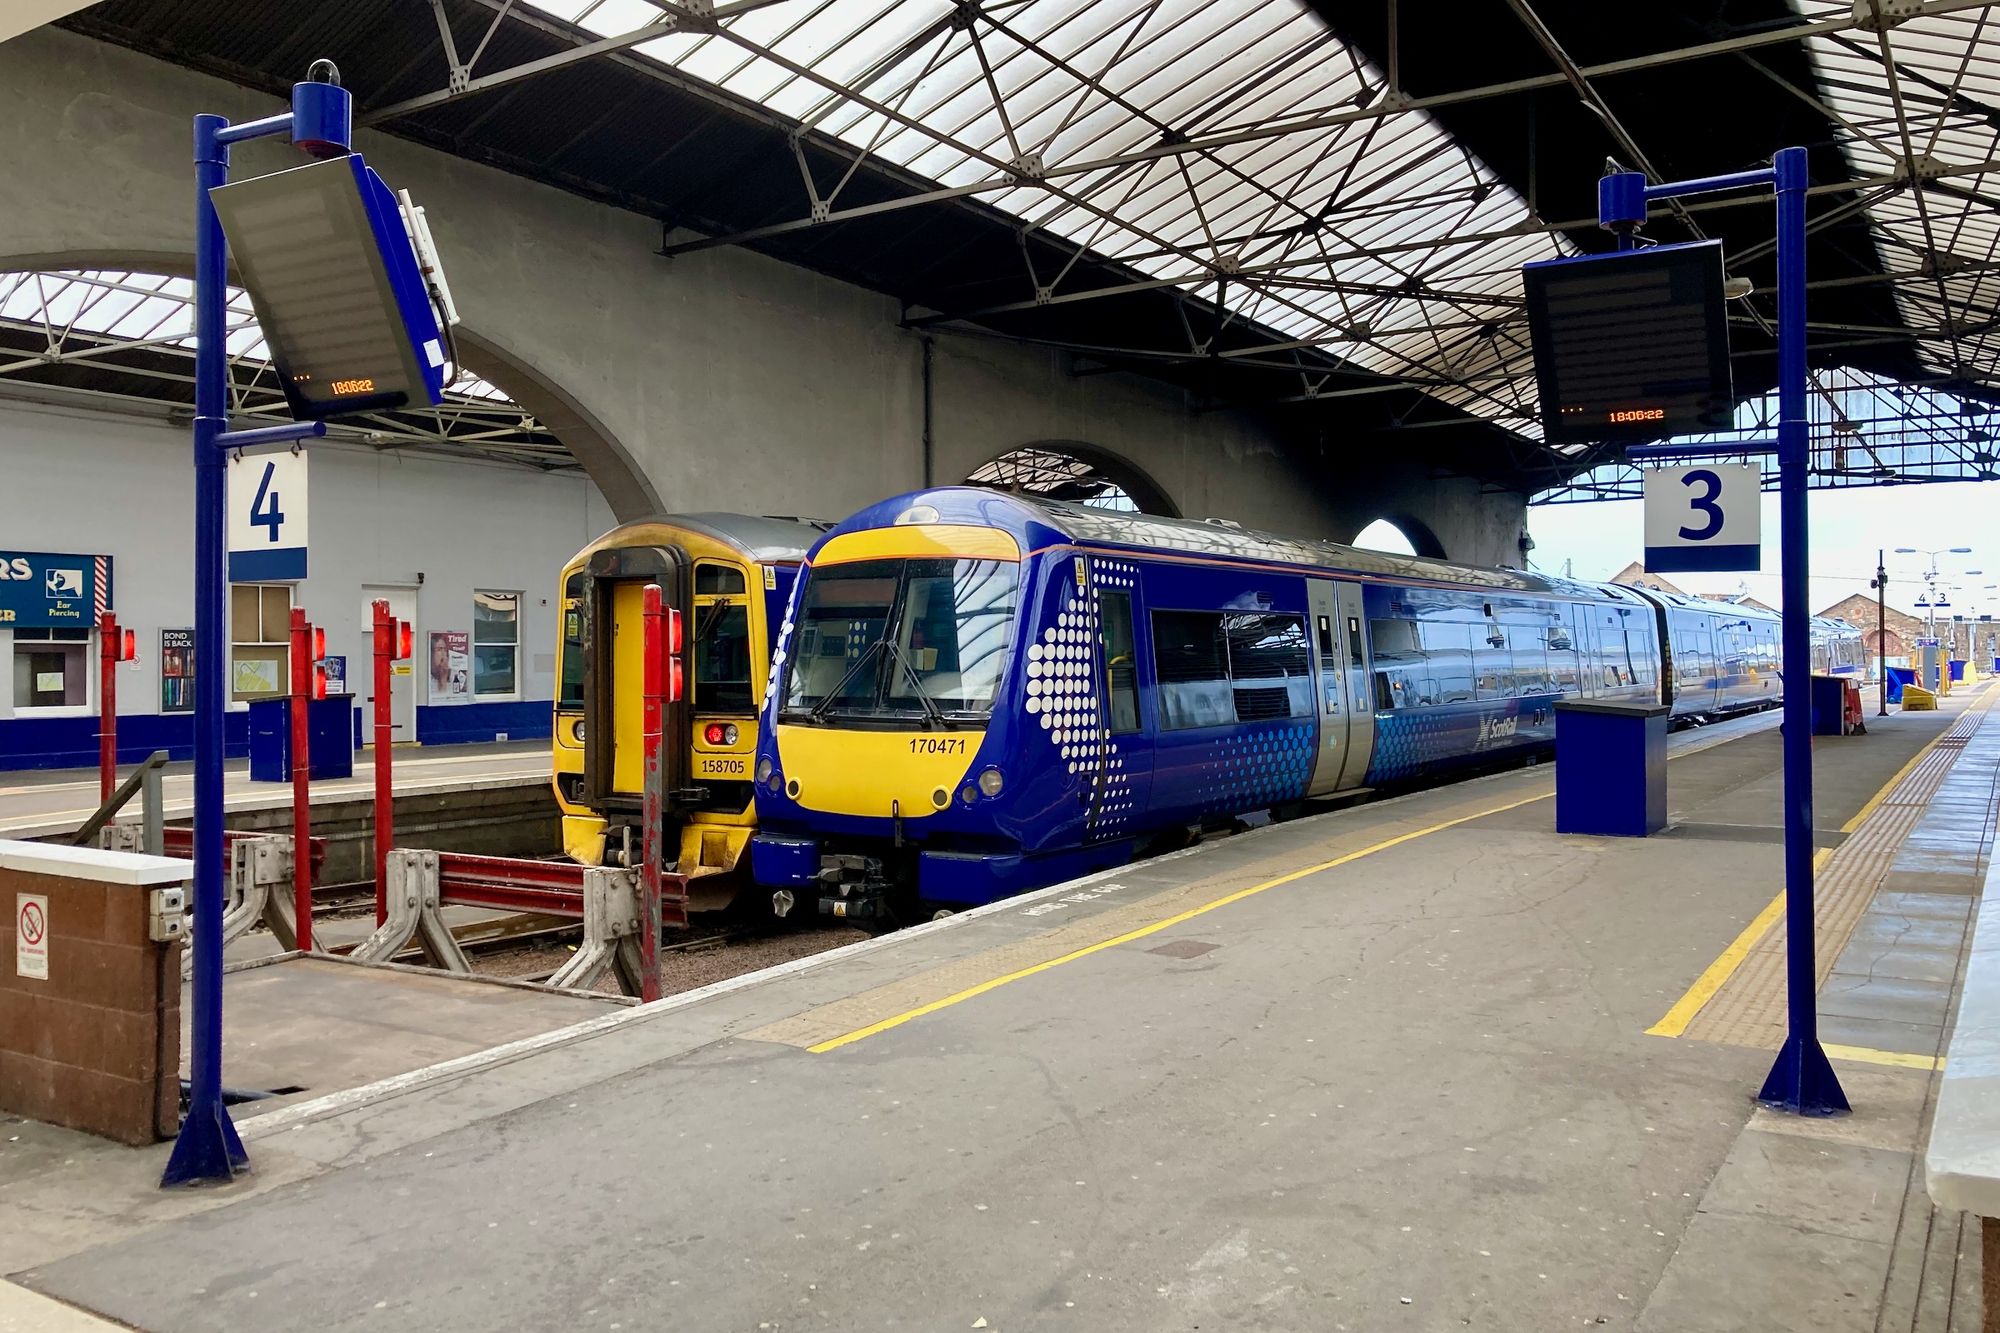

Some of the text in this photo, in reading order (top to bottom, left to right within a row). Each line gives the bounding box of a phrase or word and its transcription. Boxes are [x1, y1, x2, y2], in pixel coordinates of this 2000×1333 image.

[332, 380, 374, 394] 18:06:22
[1610, 410, 1664, 422] 18:06:22
[251, 462, 284, 542] 4
[1679, 470, 1724, 540] 3
[1918, 593, 1926, 603] 4
[1939, 592, 1946, 603] 3
[49, 609, 80, 618] Piercing
[1490, 716, 1518, 738] ScotRail
[910, 739, 965, 754] 170471
[702, 760, 744, 773] 158705
